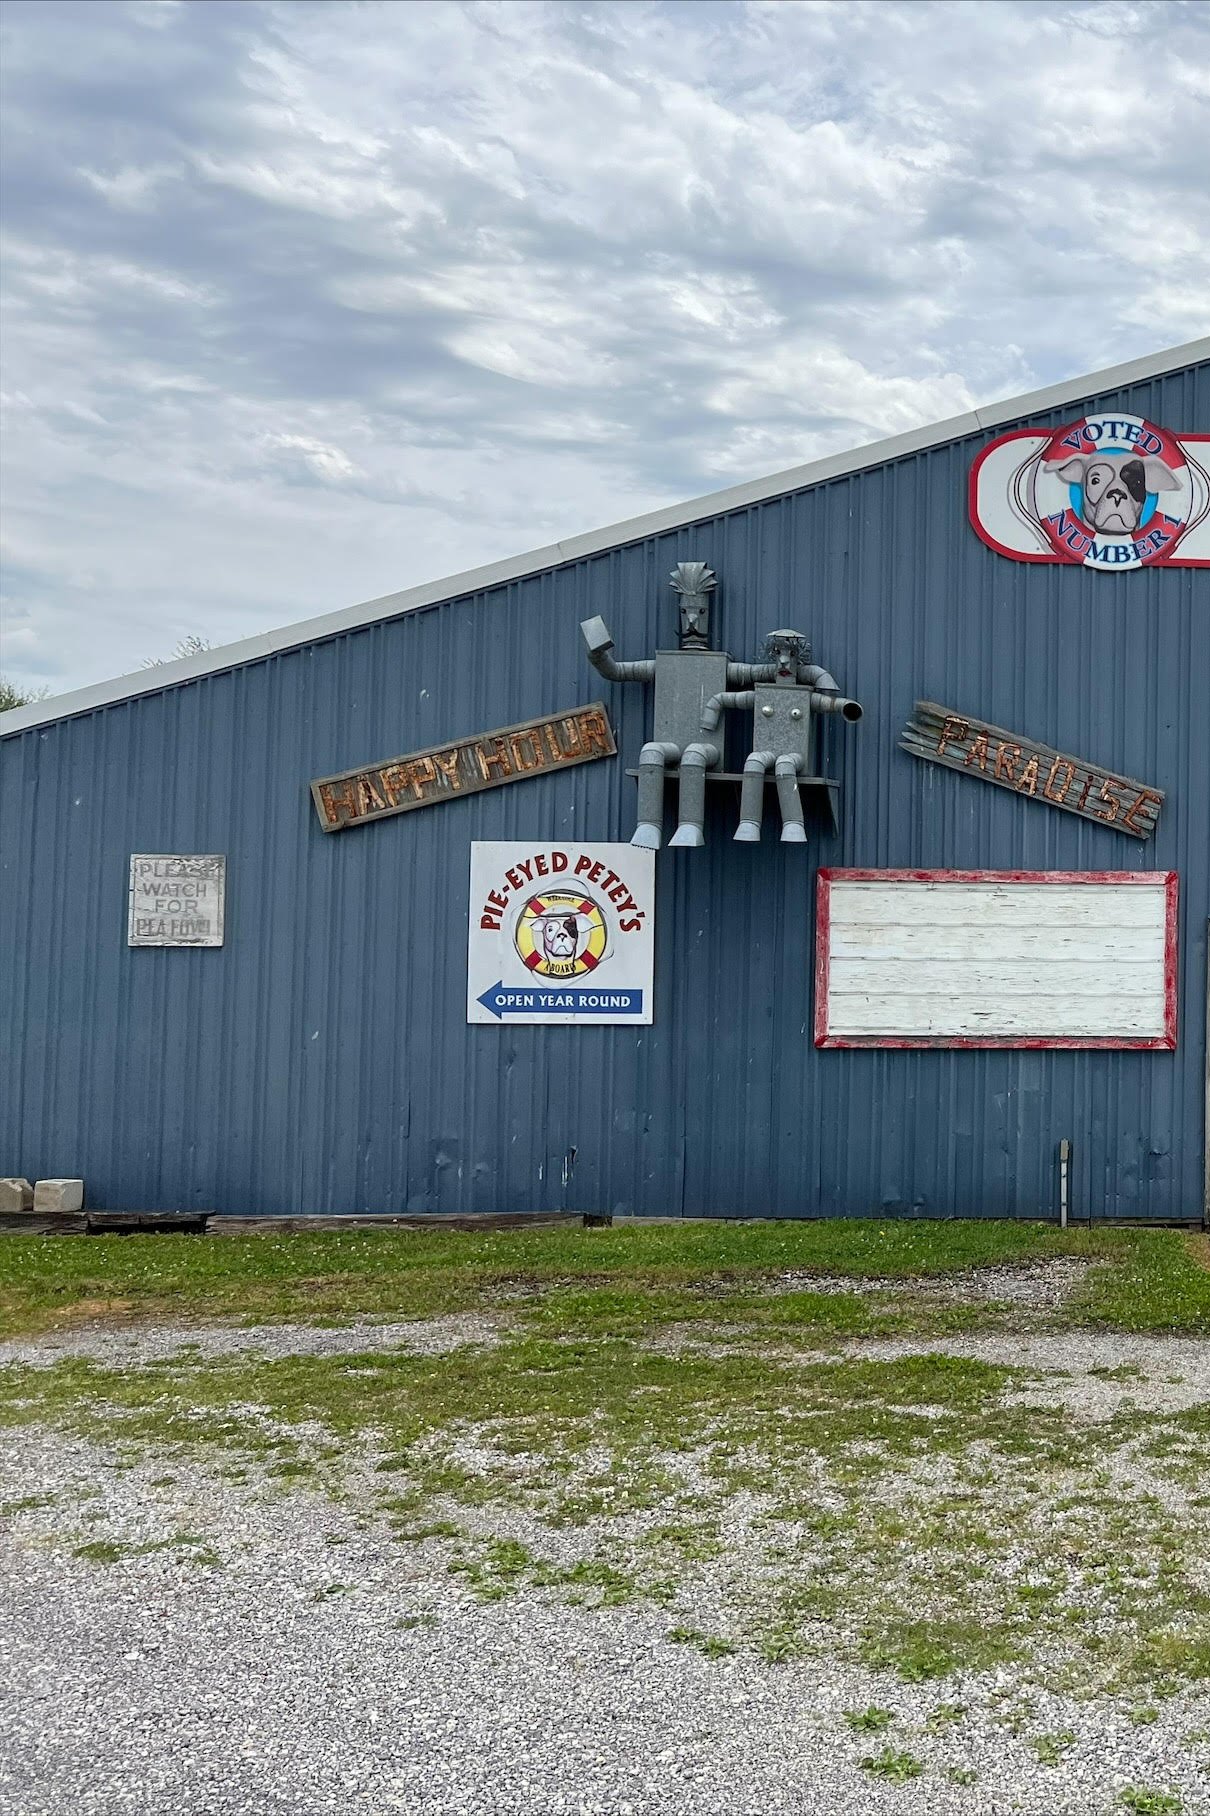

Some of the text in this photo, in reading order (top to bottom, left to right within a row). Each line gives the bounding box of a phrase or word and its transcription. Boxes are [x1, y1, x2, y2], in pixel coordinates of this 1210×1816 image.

[1062, 421, 1163, 456] VOTED
[1048, 510, 1182, 563] NUMBER 1
[319, 711, 610, 823] HAPPY HOUR
[936, 714, 1164, 834] PARADISE
[142, 883, 207, 897] WATCH
[155, 900, 198, 913] FOR
[480, 851, 646, 932] PIE-EYED PETEY'S
[495, 994, 631, 1007] OPEN YEAR ROUND
